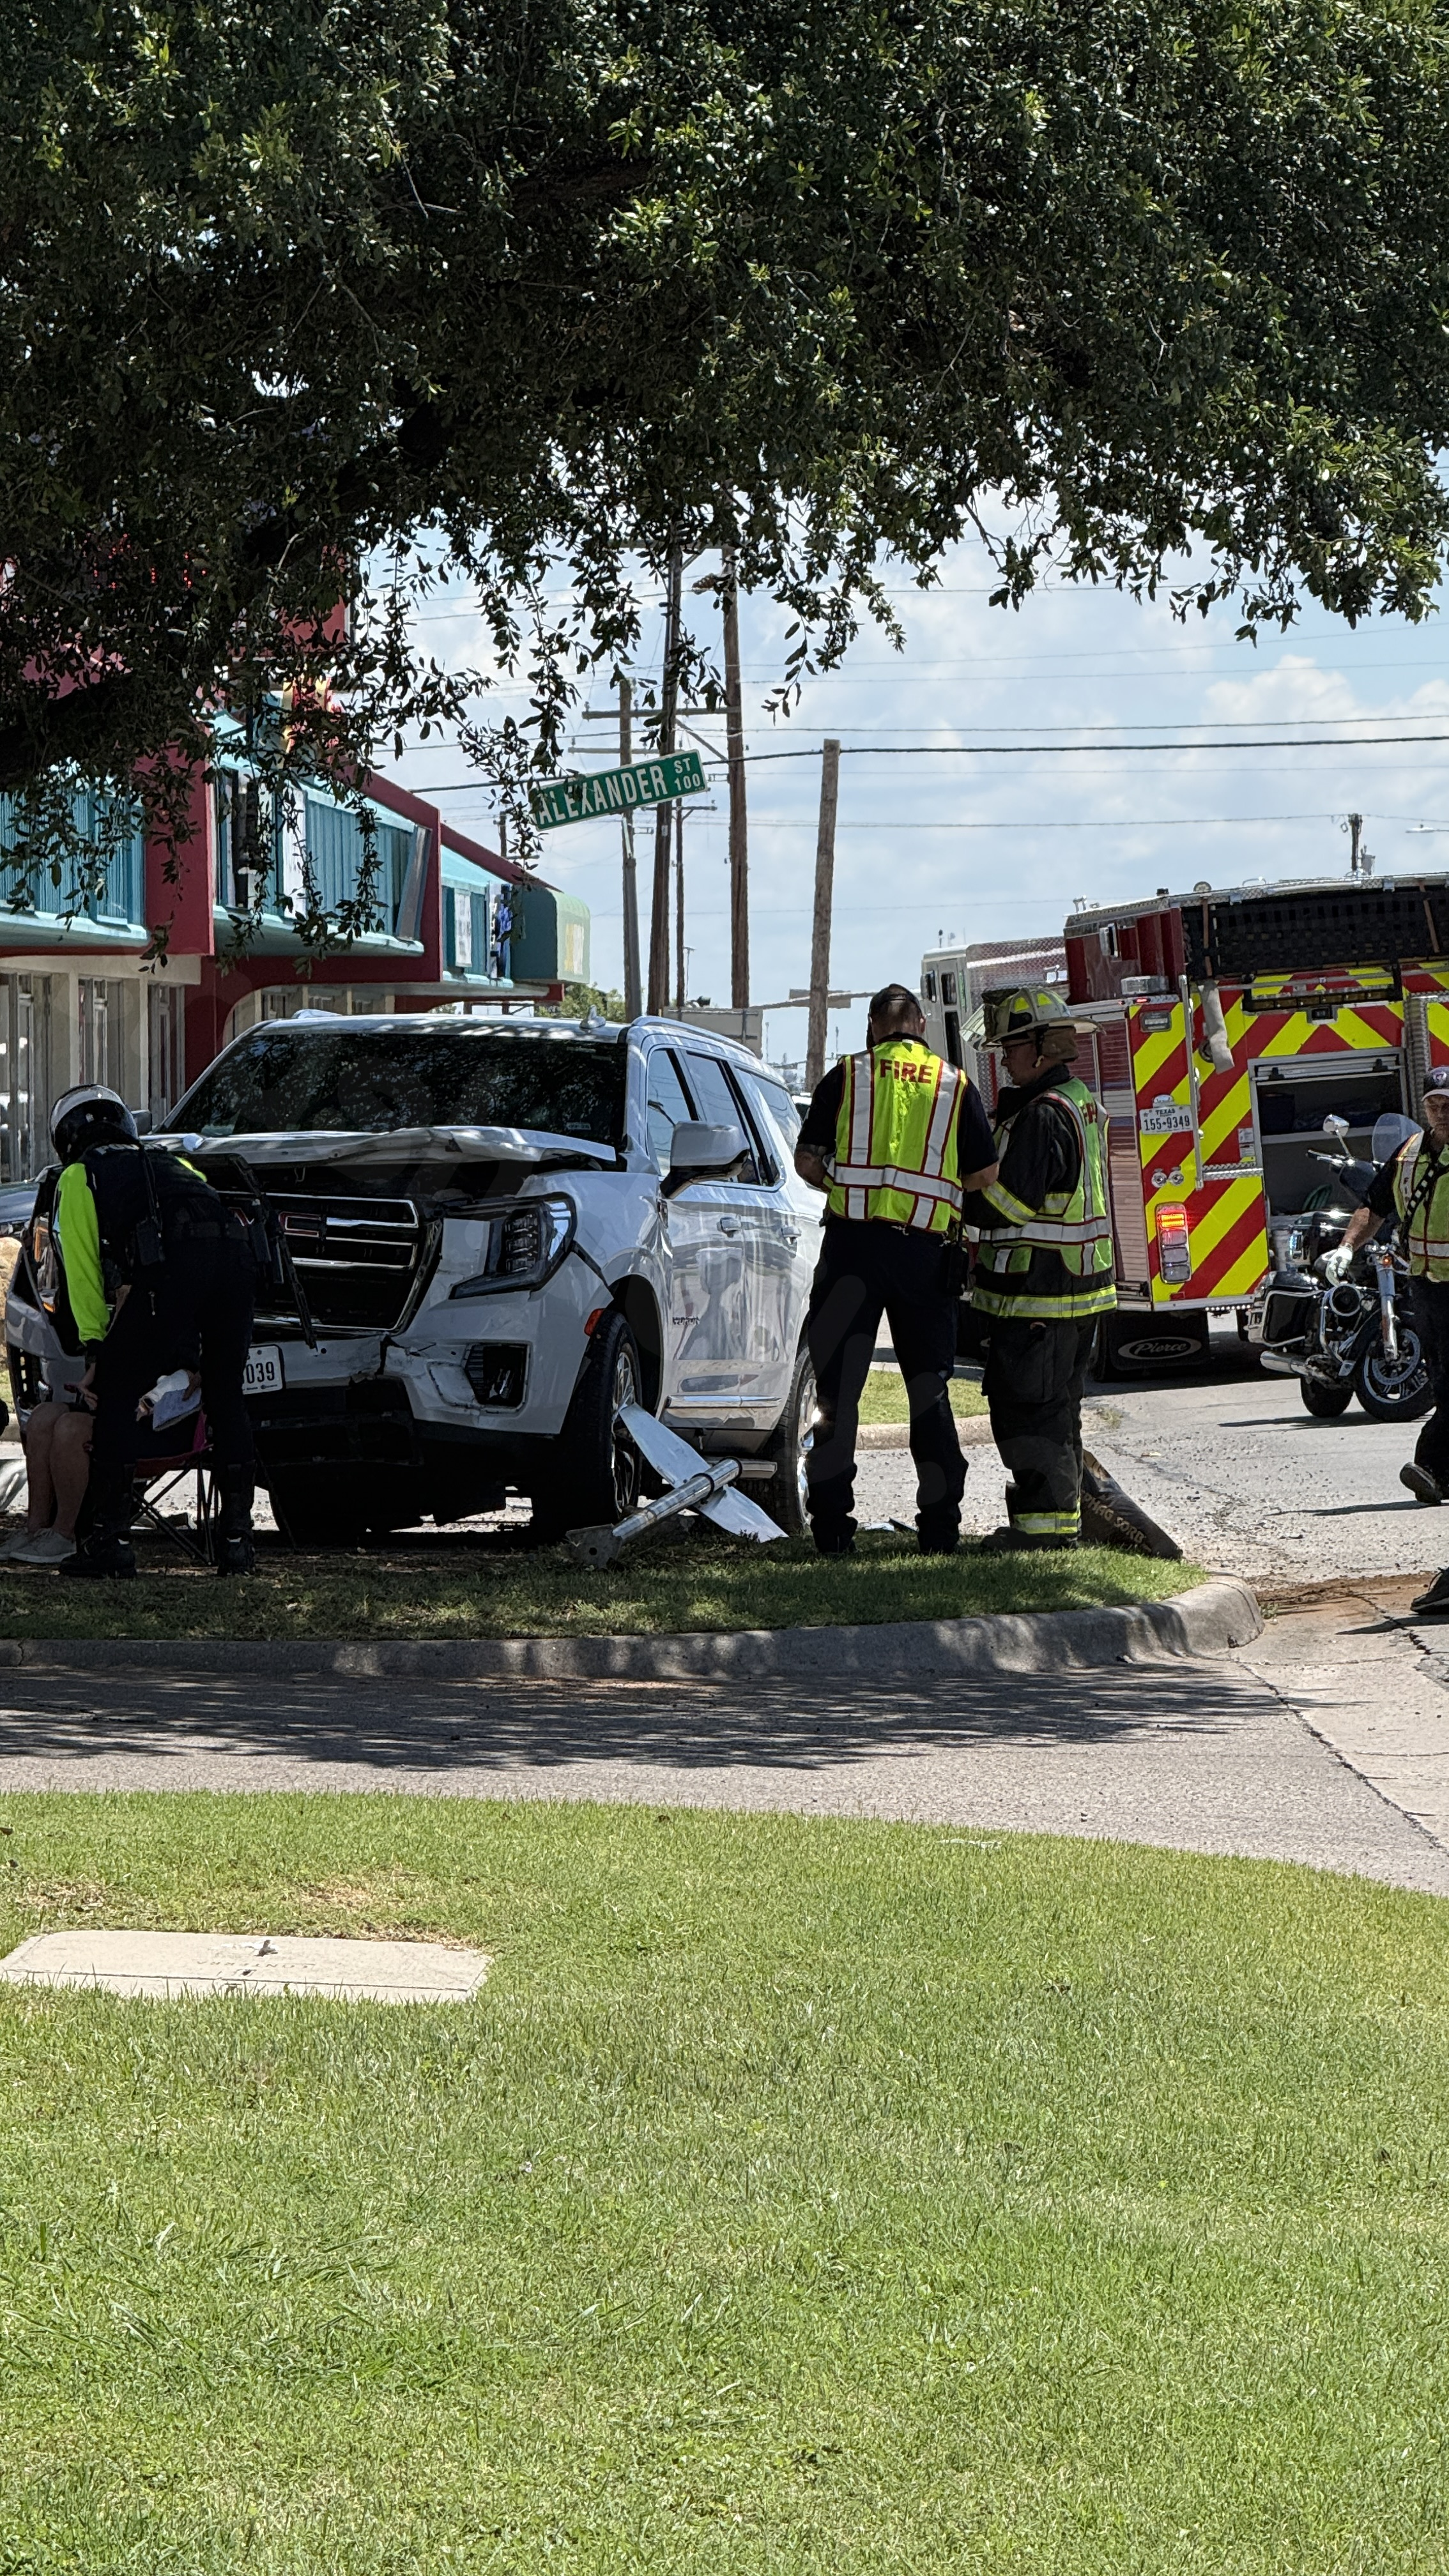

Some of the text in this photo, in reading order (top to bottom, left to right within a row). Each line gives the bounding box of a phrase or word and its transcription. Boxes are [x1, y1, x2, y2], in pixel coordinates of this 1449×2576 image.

[537, 757, 691, 825] ALEXANDER ST
[674, 773, 701, 792] 100
[880, 1059, 933, 1084] FIRE
[1133, 1342, 1187, 1355] Pierce
[1114, 1516, 1145, 1544] SORB
